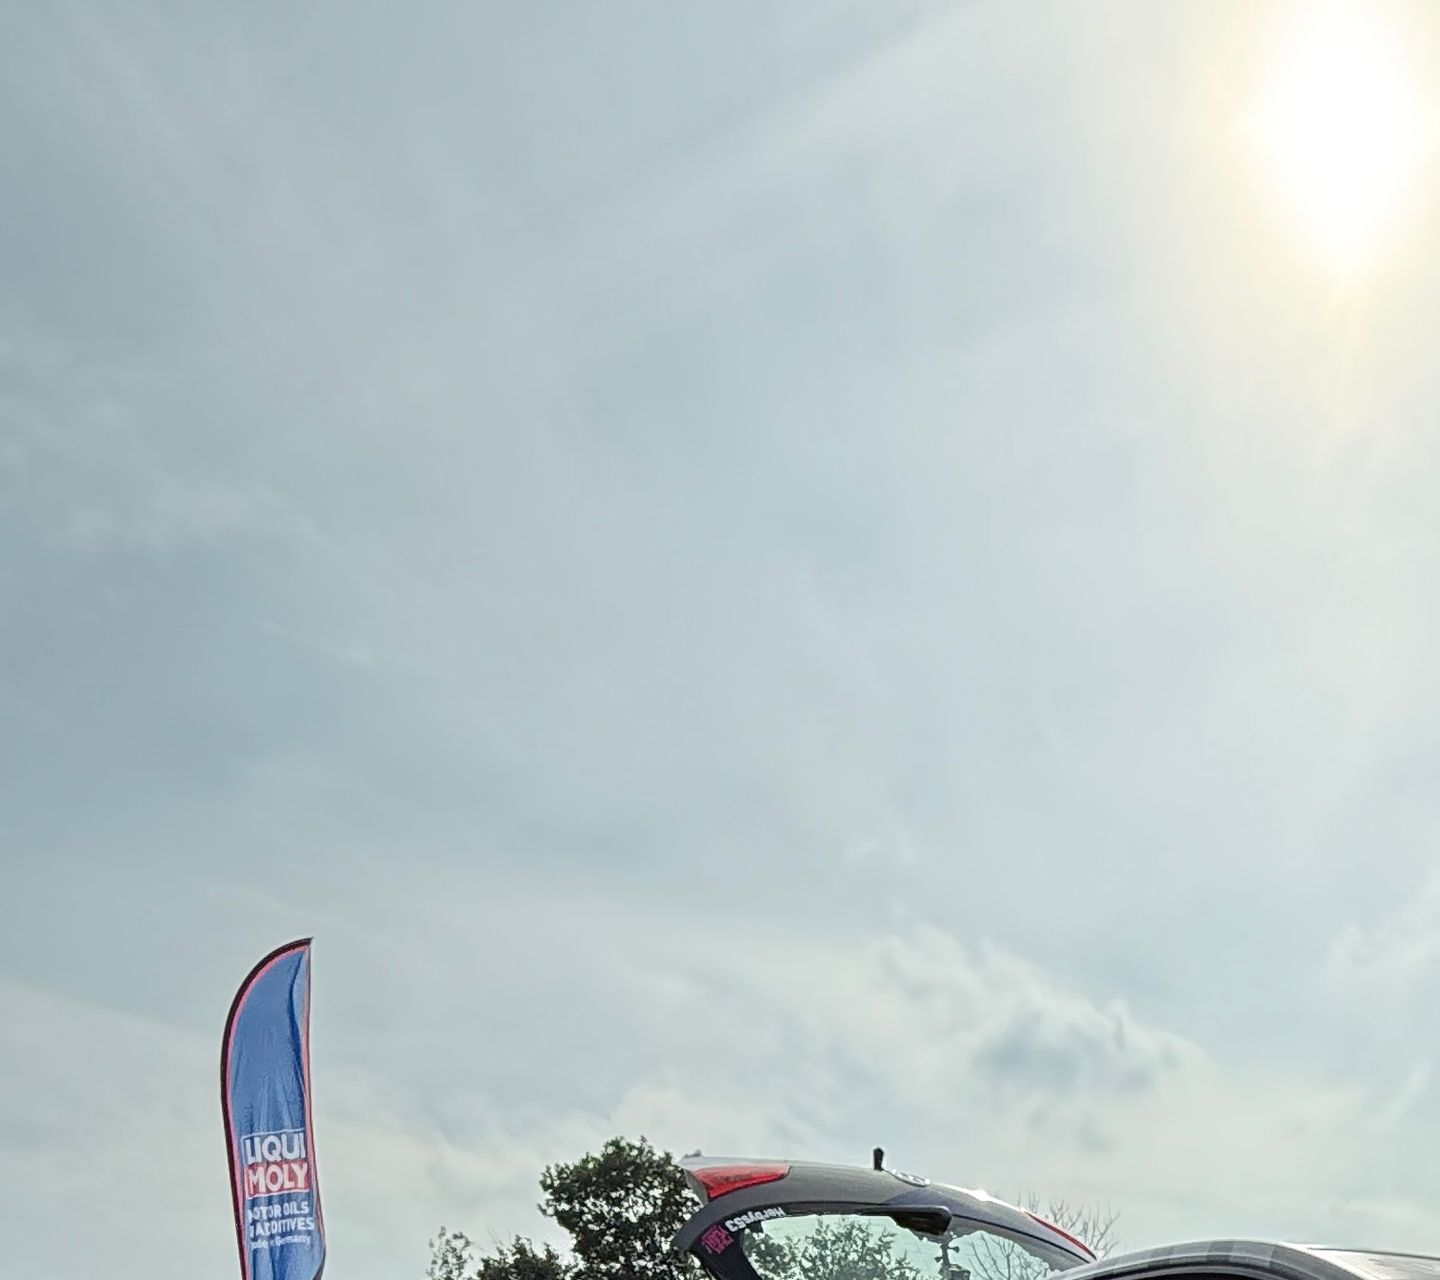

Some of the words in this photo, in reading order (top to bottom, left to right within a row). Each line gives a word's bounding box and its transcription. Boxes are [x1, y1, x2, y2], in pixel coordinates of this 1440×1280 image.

[246, 1133, 306, 1163] LIQUI
[248, 1163, 308, 1194] MOLY
[283, 1201, 309, 1215] OILS
